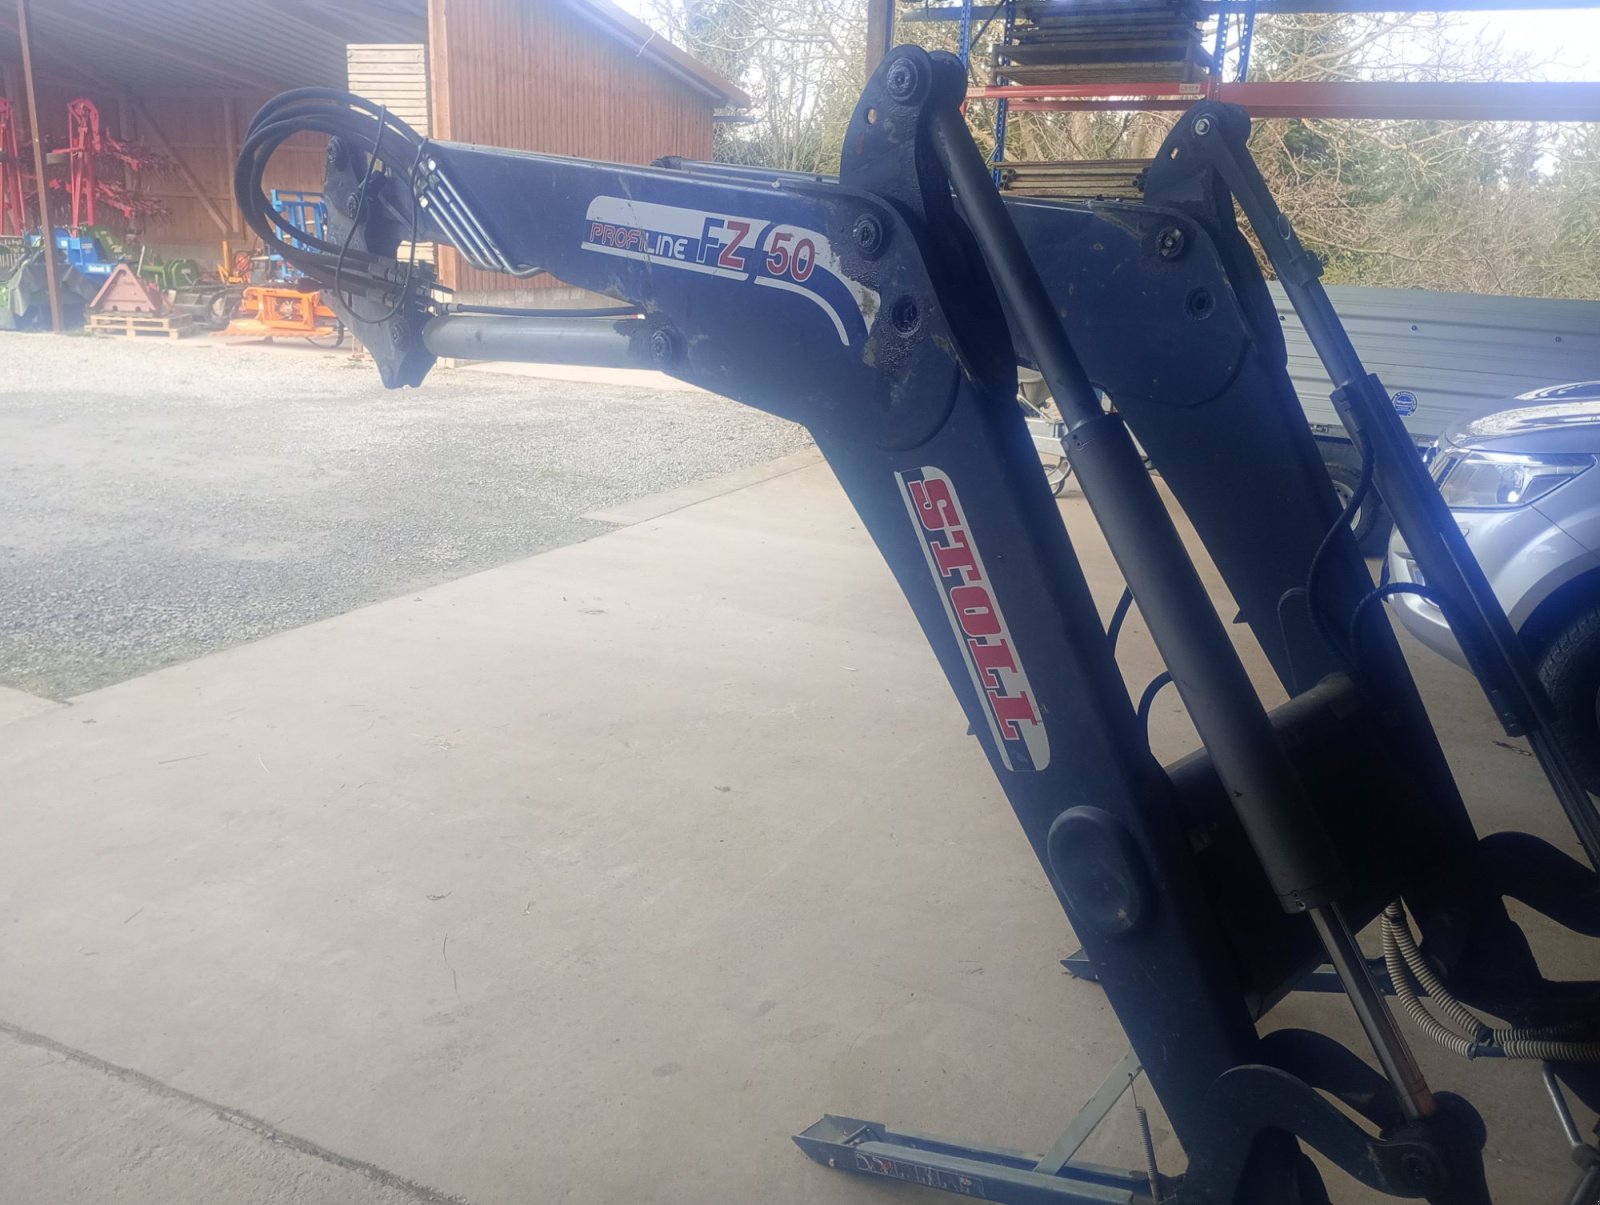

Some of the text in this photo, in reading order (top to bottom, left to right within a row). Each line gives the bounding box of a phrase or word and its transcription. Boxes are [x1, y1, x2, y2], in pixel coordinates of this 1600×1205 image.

[696, 216, 751, 270] FZ
[766, 231, 816, 282] 50
[907, 477, 1039, 741] STOLL
